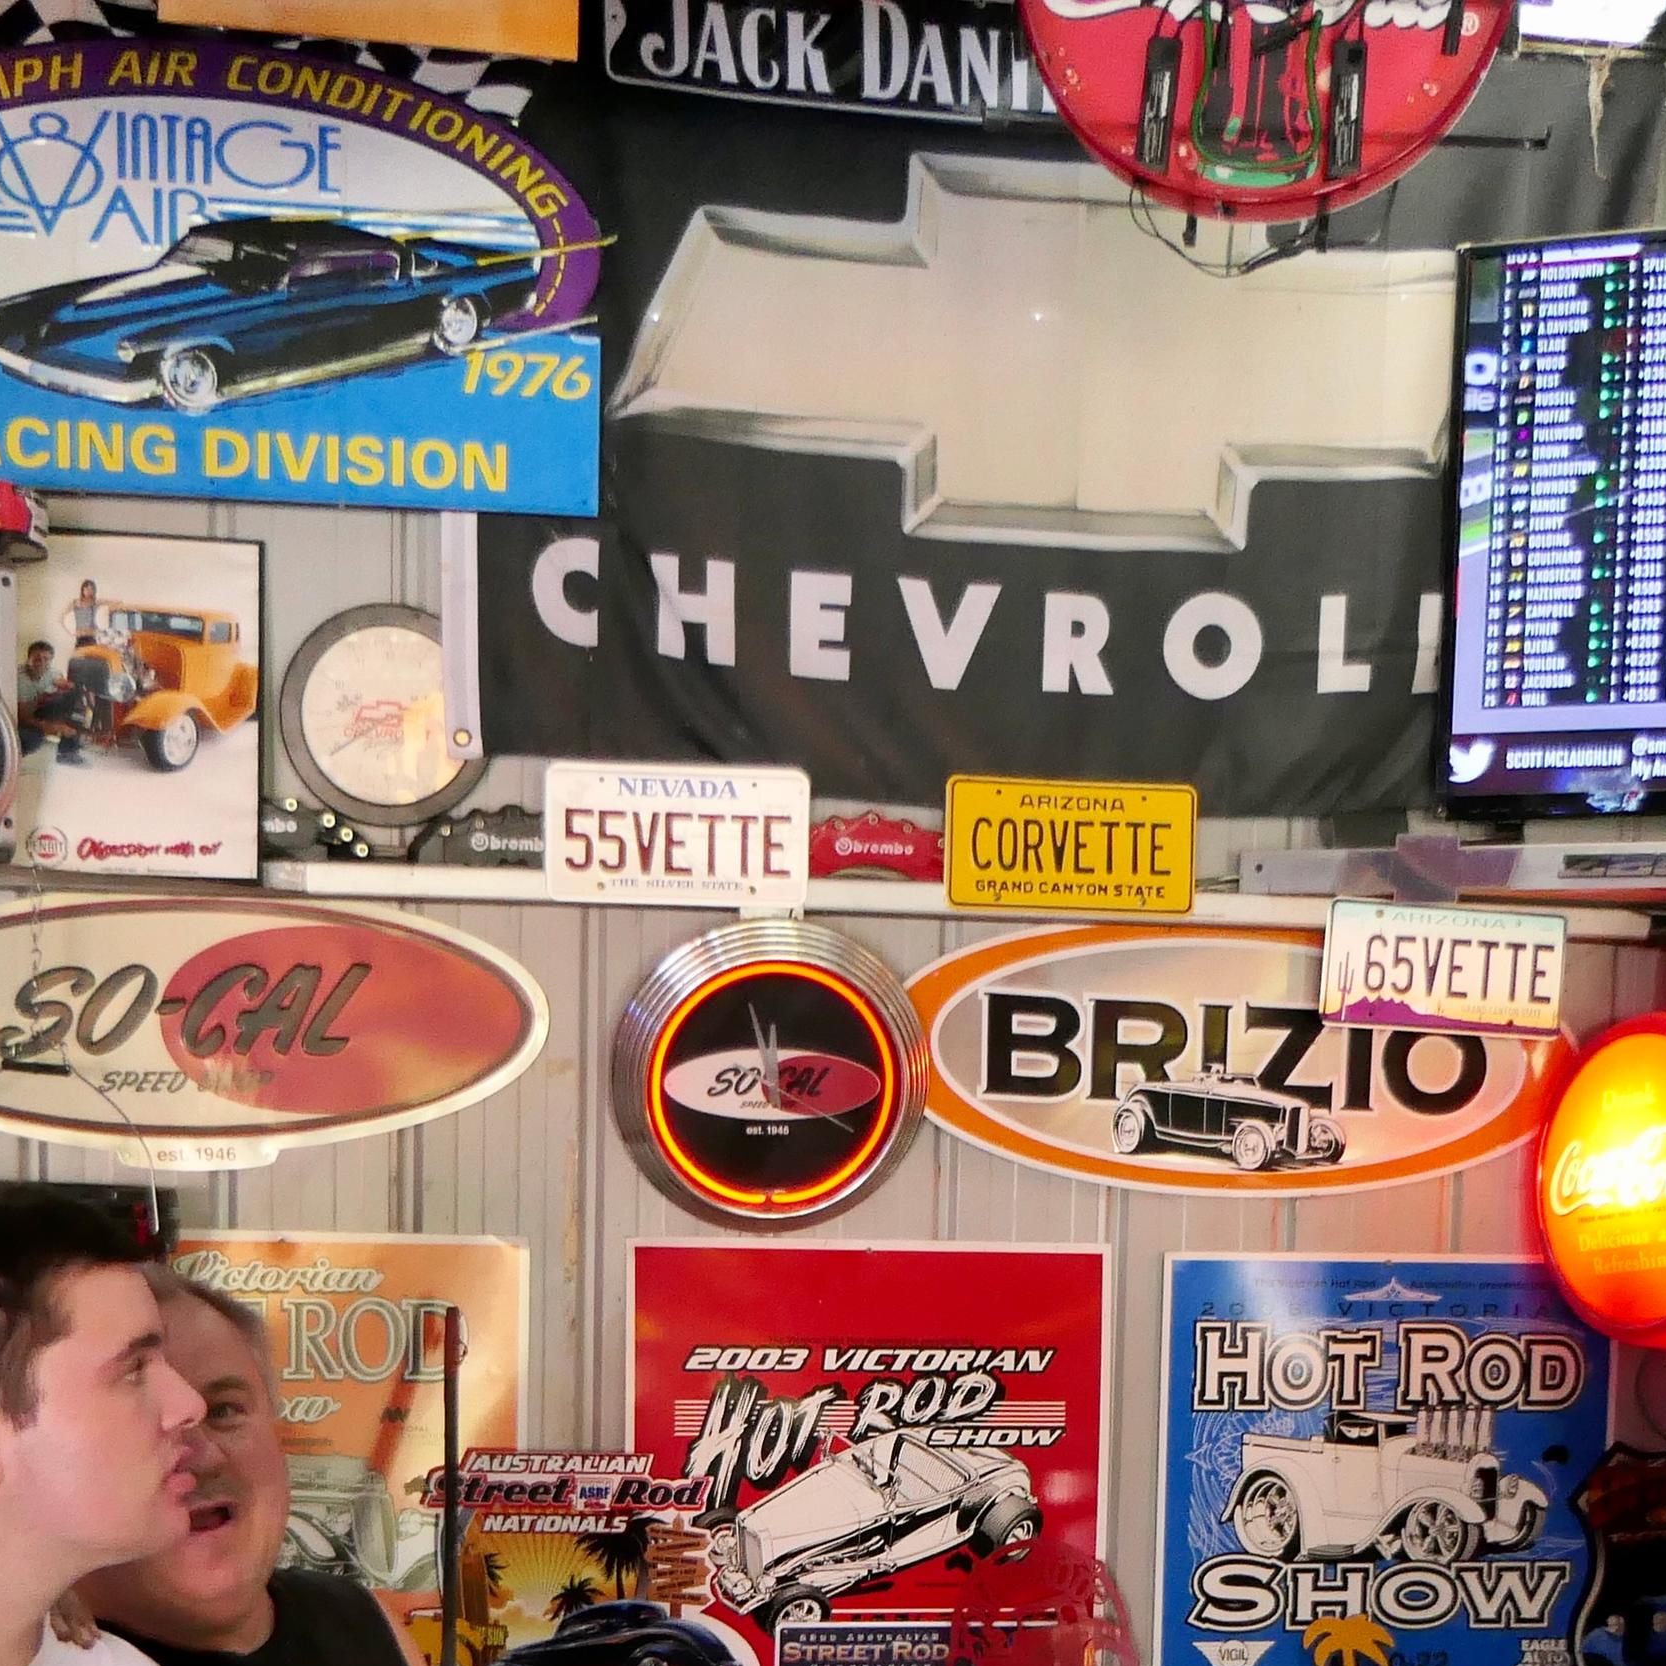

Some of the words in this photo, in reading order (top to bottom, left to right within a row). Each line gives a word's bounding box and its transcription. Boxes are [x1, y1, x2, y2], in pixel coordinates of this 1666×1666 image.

[638, 3, 834, 93] JACK
[109, 49, 194, 87] AIR
[227, 57, 570, 219] CONDITIONING
[461, 350, 592, 401] 1976
[203, 427, 509, 494] DIVISION
[1506, 751, 1543, 769] SCOTT
[1544, 748, 1623, 768] MCLAUGHLIN
[1631, 757, 1651, 781] My
[617, 777, 739, 802] NEVADA
[1019, 795, 1126, 814] ARIZONA
[565, 809, 793, 878] 55VETTE
[852, 839, 915, 859] brembo
[970, 815, 1171, 878] CORVETTE
[610, 877, 640, 890] THE
[645, 878, 697, 892] SILVER
[701, 881, 745, 894] STATE
[975, 879, 1033, 896] GRAND
[1037, 880, 1107, 898] CANYON
[1112, 882, 1166, 900] STATE
[1364, 932, 1558, 1002] 65VETTE
[981, 991, 1487, 1117] BRIZIO
[99, 1068, 188, 1098] SPEED
[157, 1145, 186, 1165] est.
[194, 1145, 238, 1165] 1946
[1577, 1229, 1651, 1252] Delicious
[169, 1249, 383, 1294] Victorian
[284, 1298, 469, 1384] ROD
[684, 1347, 812, 1372] 2003
[821, 1347, 1056, 1374] VICTORIAN
[1193, 1319, 1381, 1411] HOT
[1397, 1321, 1586, 1413] ROD
[685, 1376, 838, 1506] HOT
[852, 1369, 998, 1441] ROD
[927, 1426, 1065, 1448] SHOW
[472, 1454, 651, 1474] AUSTRALIAN
[614, 1475, 712, 1508] Rod
[484, 1514, 631, 1534] NATIONALS
[1187, 1554, 1574, 1631] SHOW
[782, 1641, 888, 1661] STREET
[891, 1641, 951, 1661] ROD
[1218, 1648, 1250, 1663] VIGIL
[1521, 1638, 1568, 1652] EAGLE
